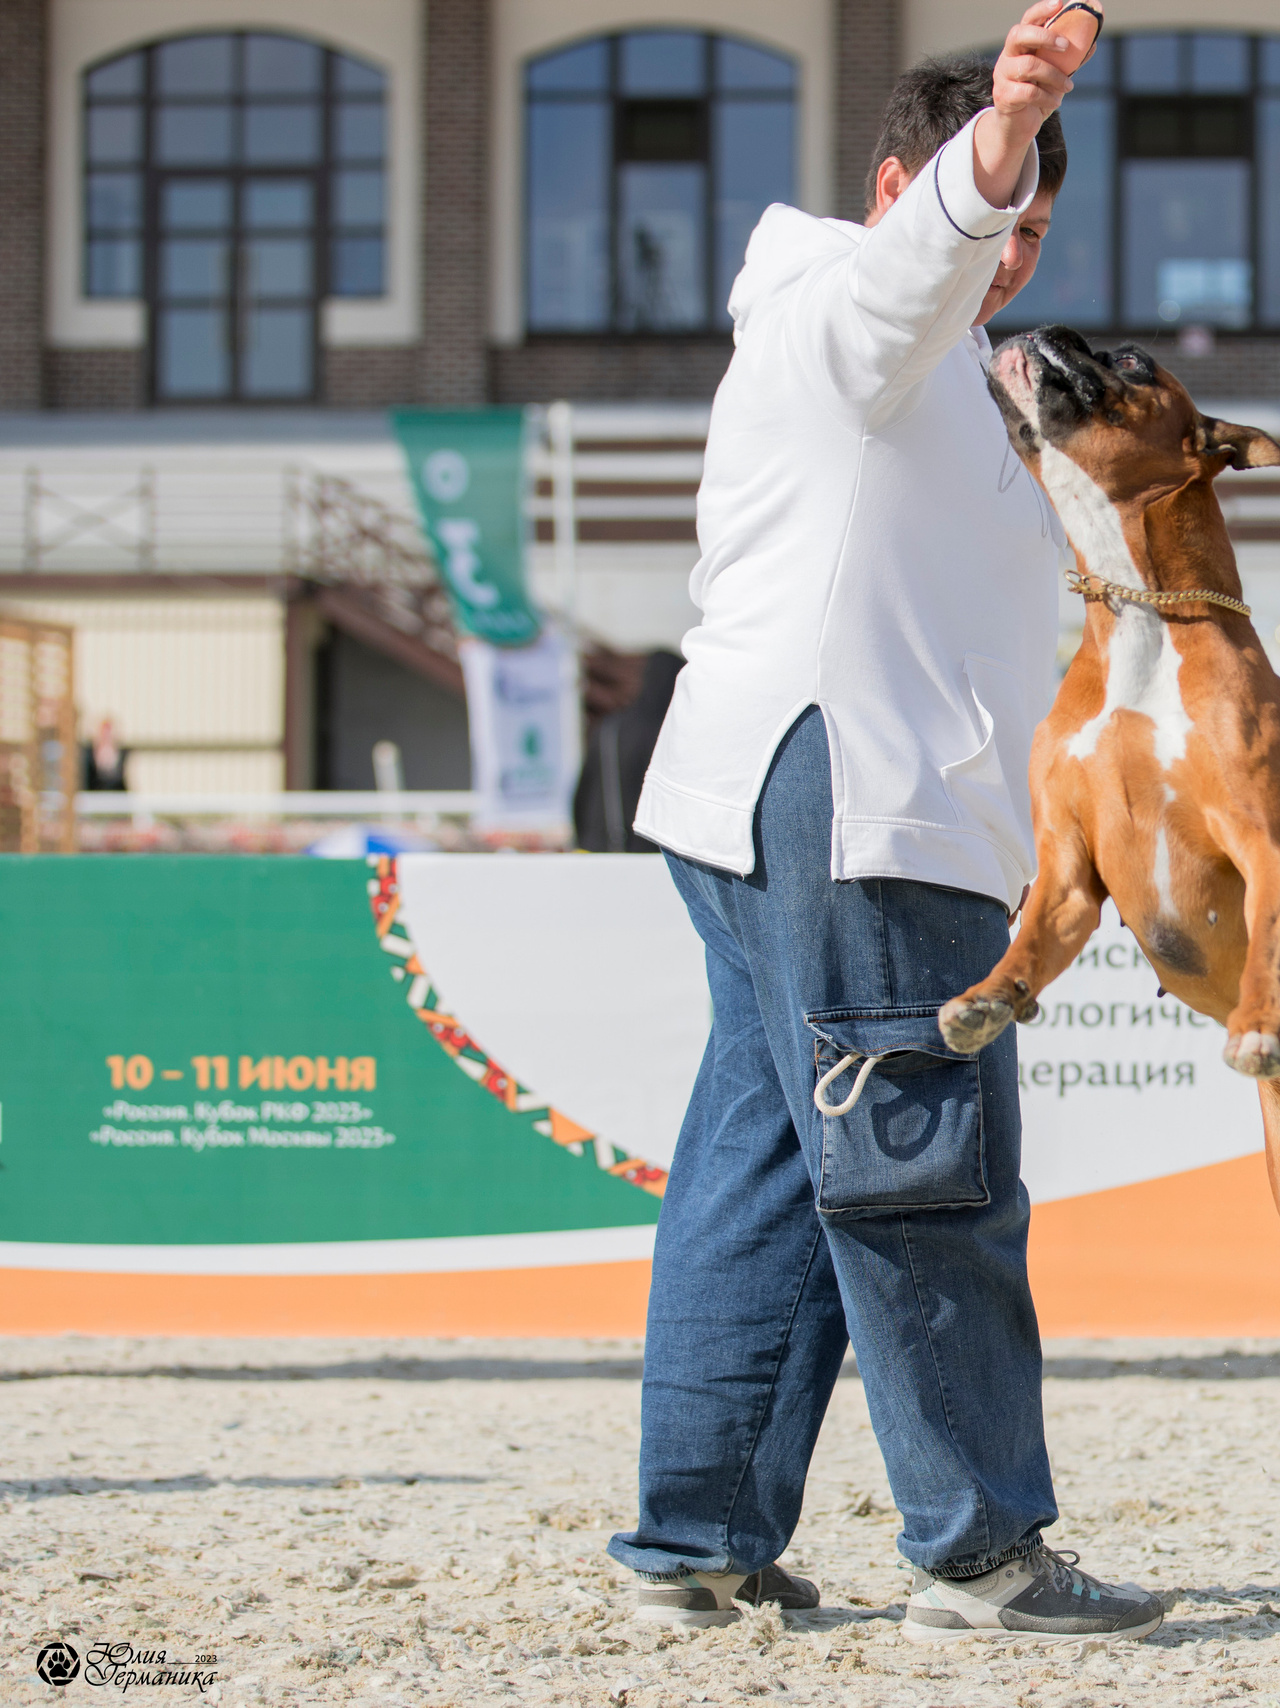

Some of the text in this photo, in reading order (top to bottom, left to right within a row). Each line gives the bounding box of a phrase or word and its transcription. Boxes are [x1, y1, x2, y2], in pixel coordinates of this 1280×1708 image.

[1021, 1002, 1224, 1029] ологиче
[105, 1054, 154, 1091] 10
[191, 1055, 230, 1091] 11
[238, 1055, 377, 1092] ИЮНЯ
